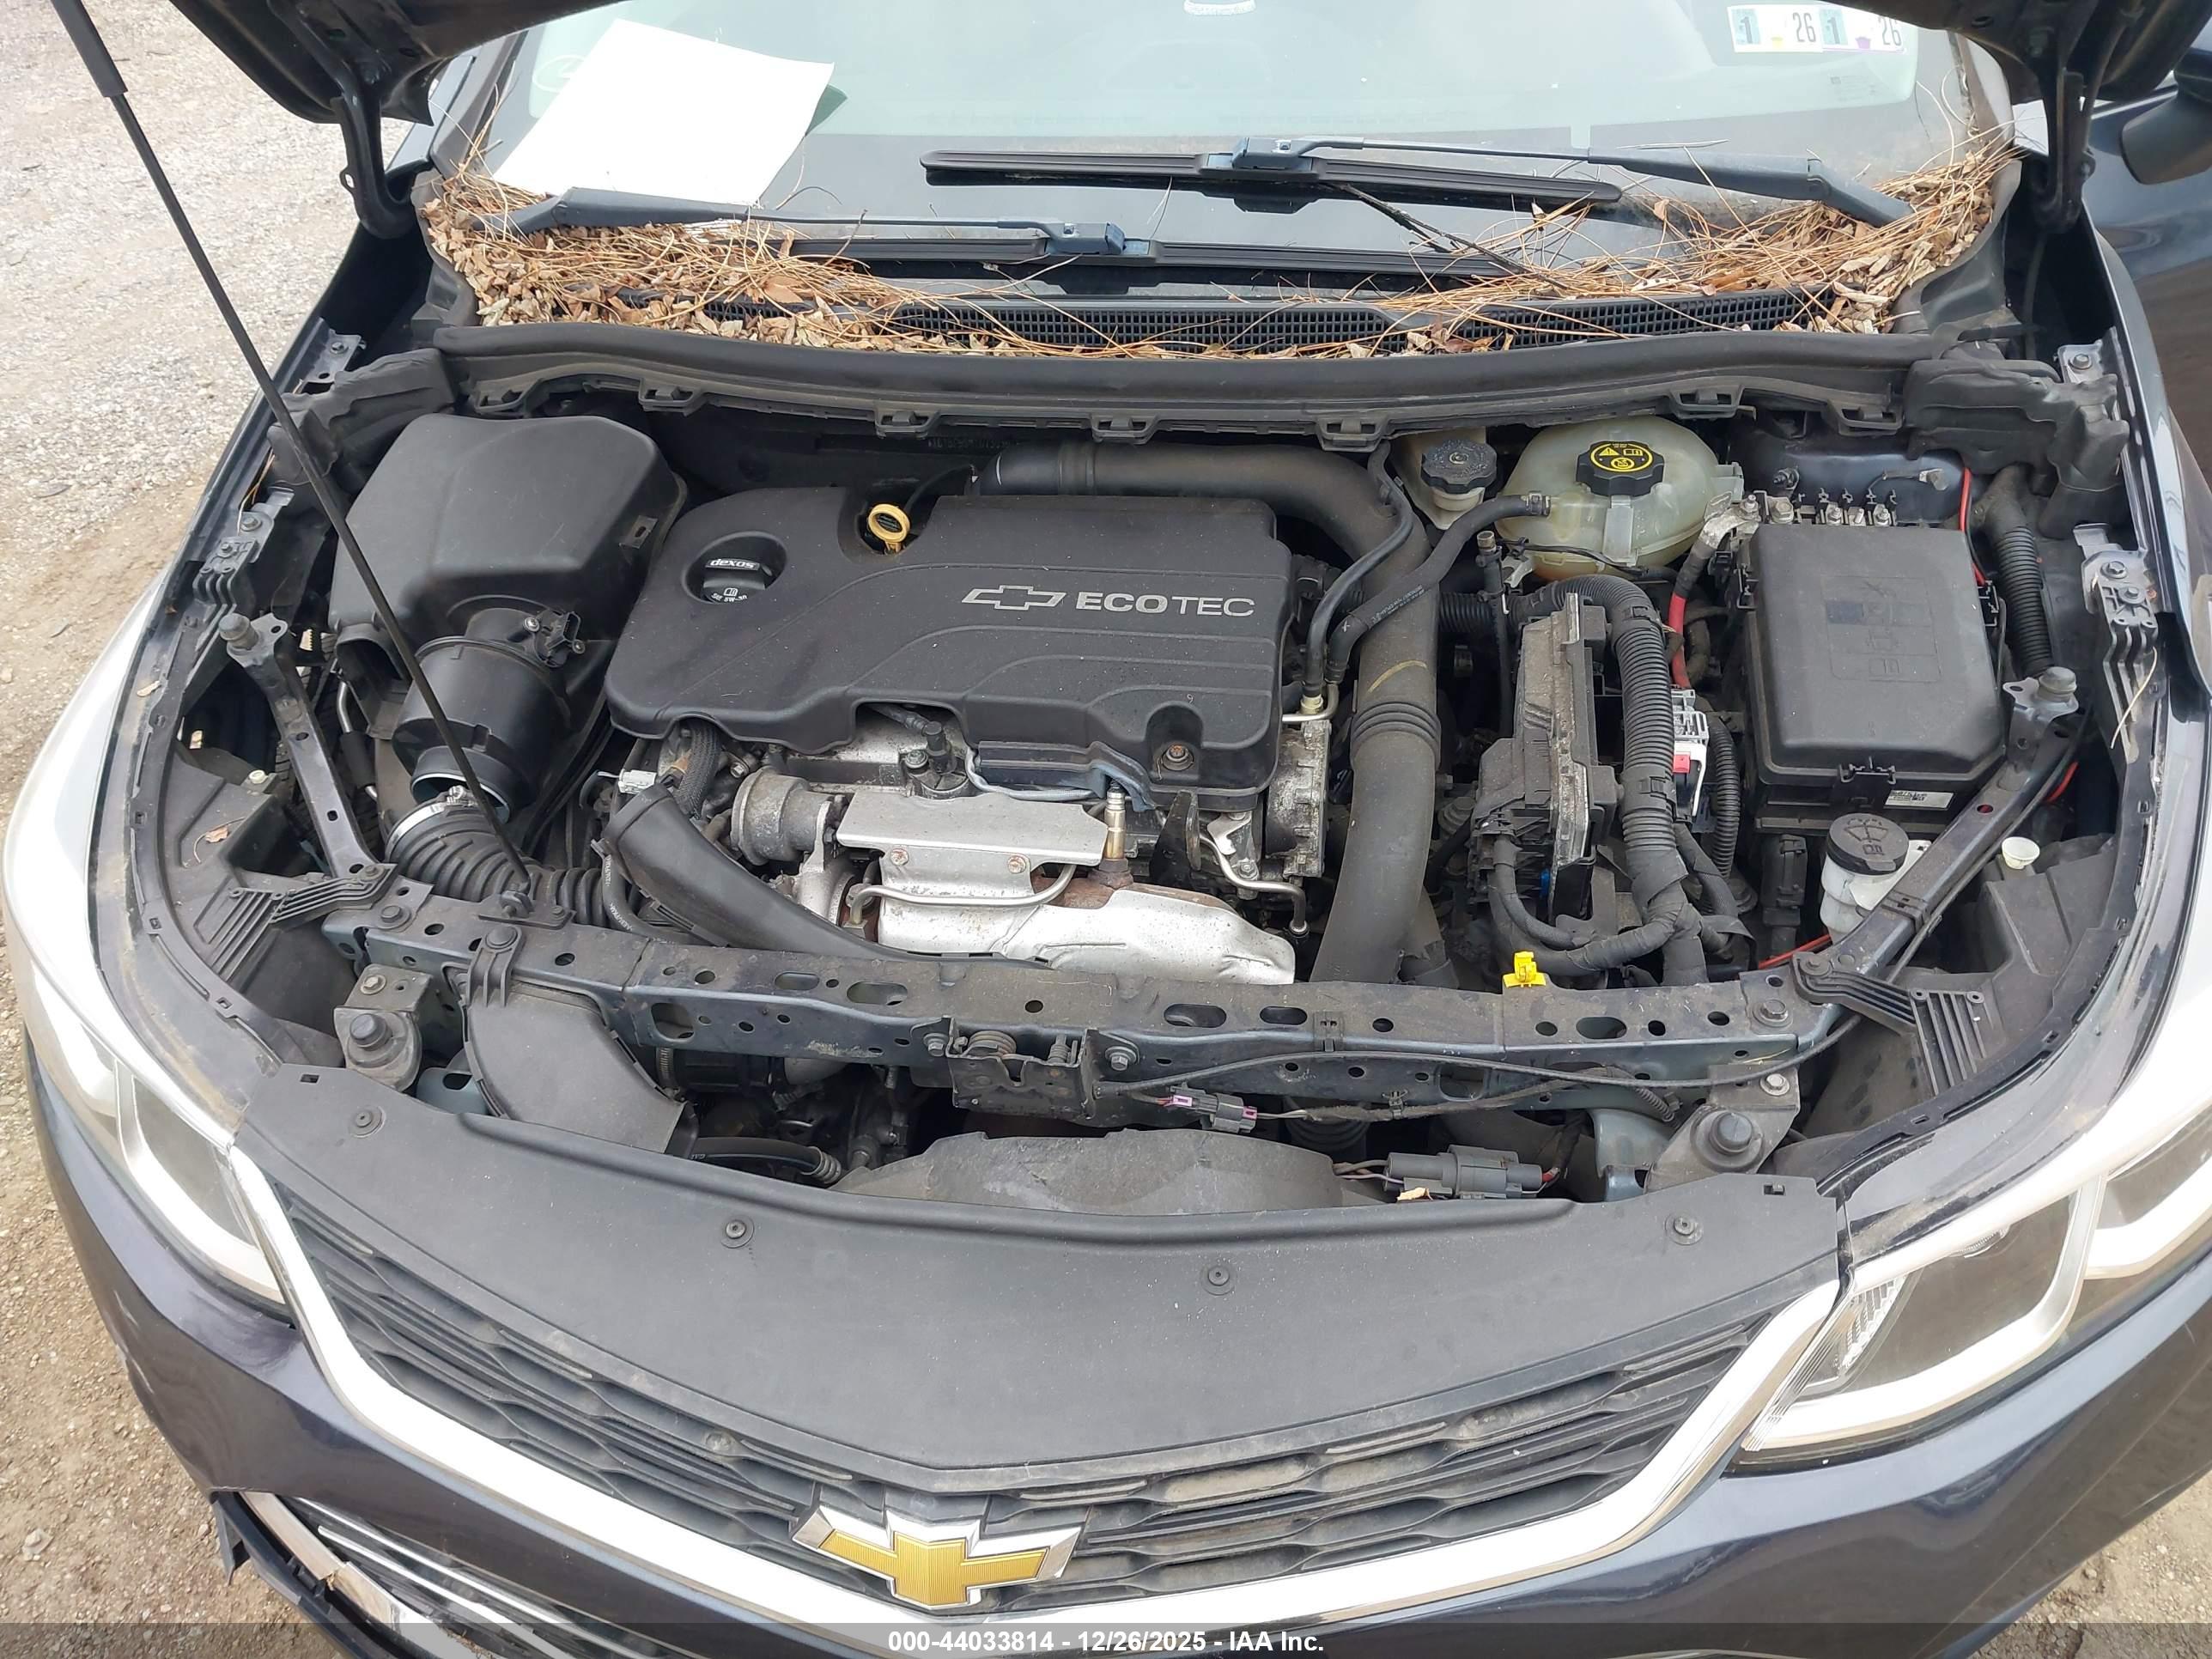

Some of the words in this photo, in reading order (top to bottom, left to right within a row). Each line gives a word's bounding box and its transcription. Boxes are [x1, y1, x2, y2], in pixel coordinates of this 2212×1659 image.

[1740, 15, 1753, 44] 1
[1792, 12, 1817, 44] 26
[1826, 16, 1840, 45] 1
[1878, 15, 1903, 46] 26
[709, 558, 755, 568] dexos
[1076, 592, 1256, 617] ECOTEC
